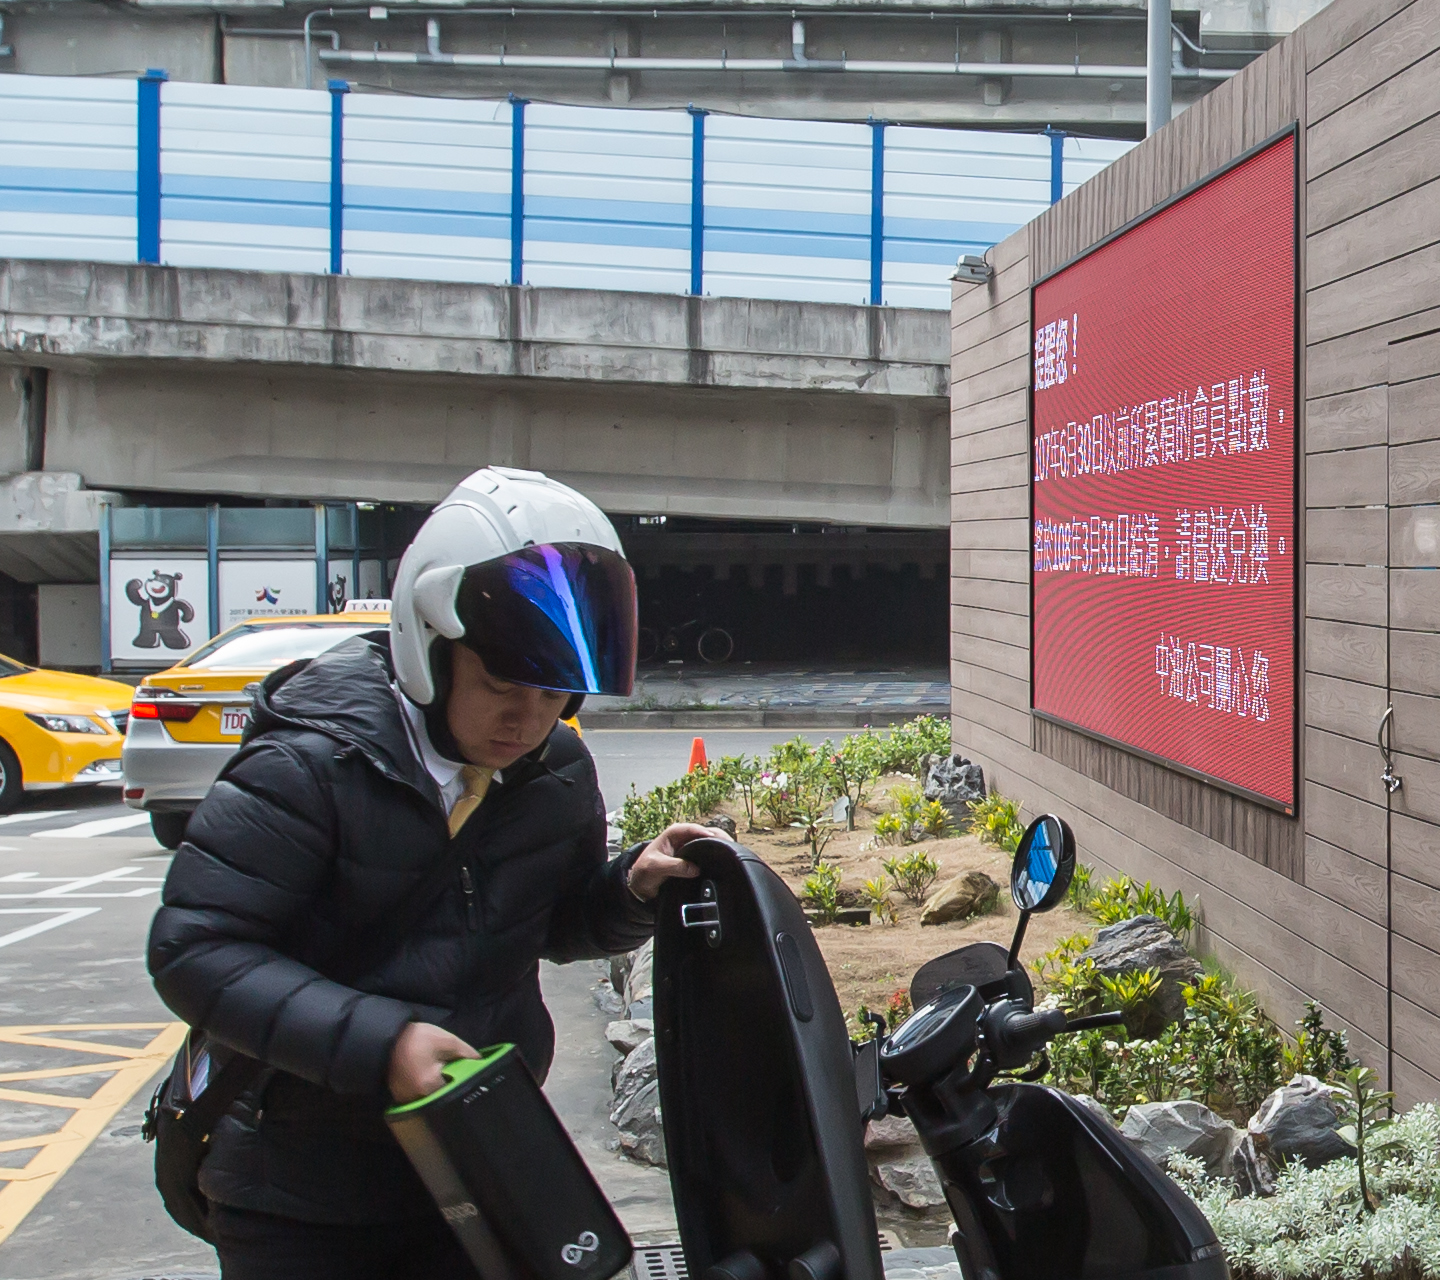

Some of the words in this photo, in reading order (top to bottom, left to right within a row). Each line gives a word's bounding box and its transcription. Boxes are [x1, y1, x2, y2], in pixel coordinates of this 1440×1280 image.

[351, 602, 387, 611] TAXI
[1156, 632, 1269, 721] 中油公司關心您
